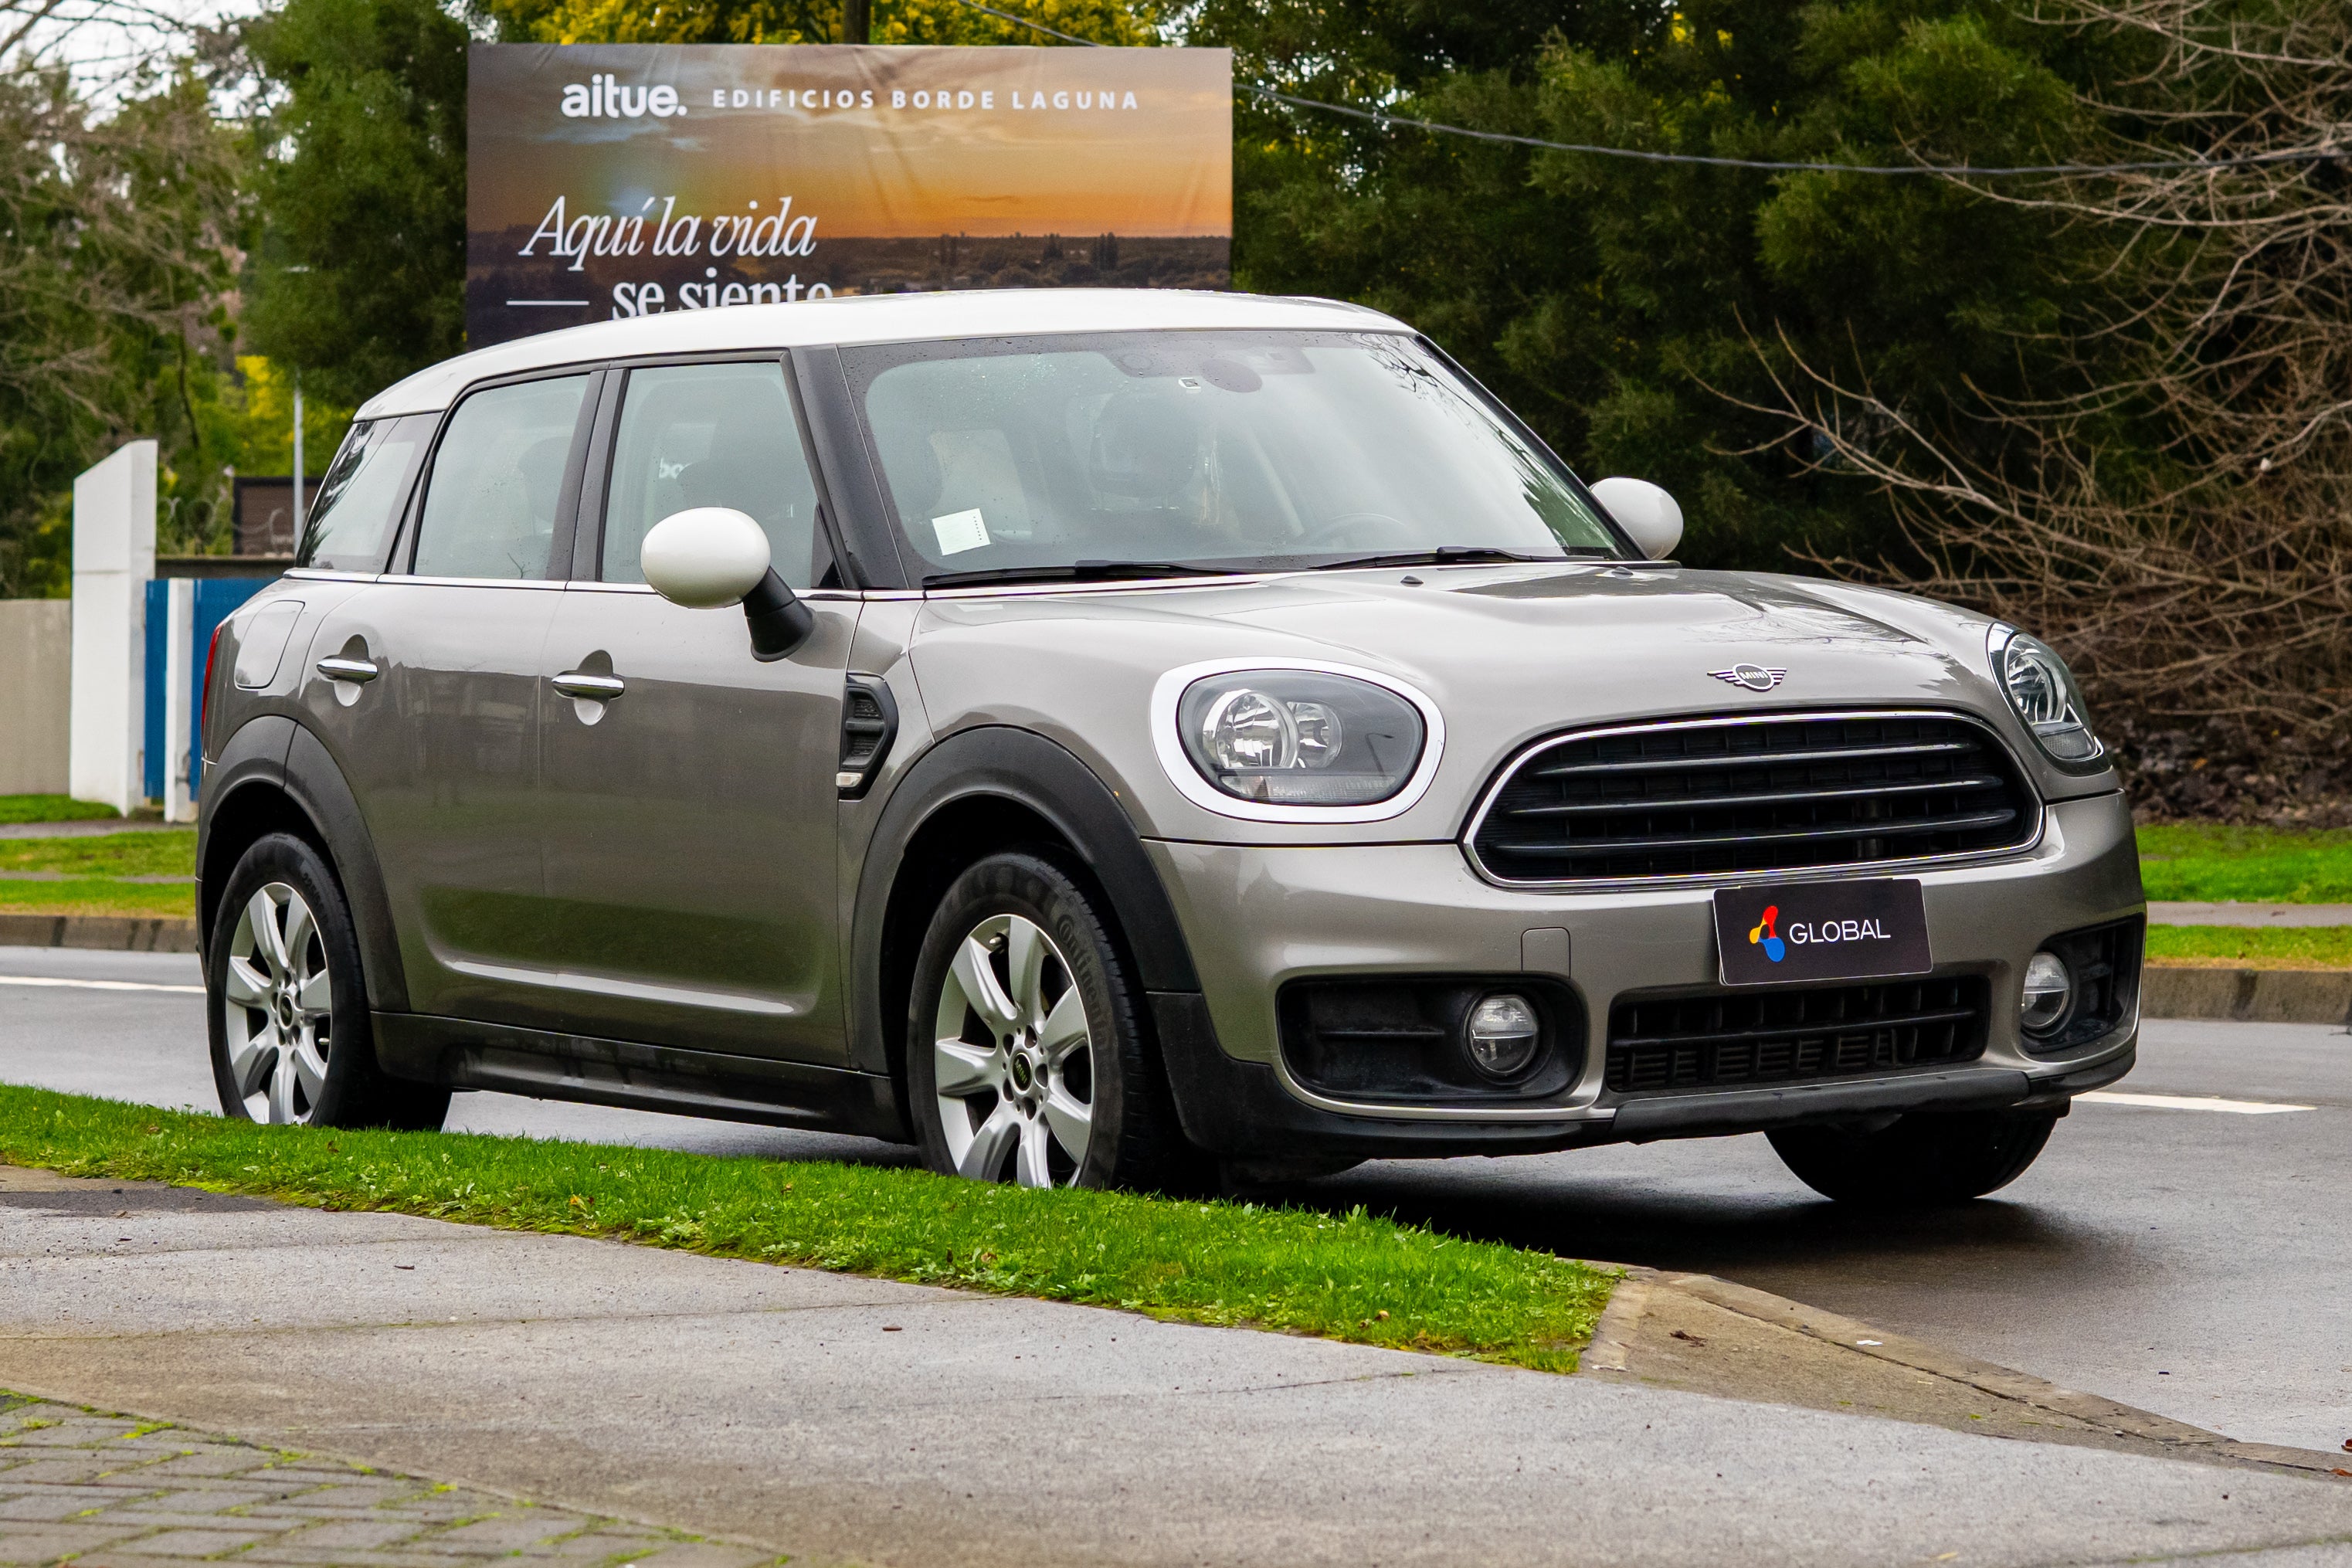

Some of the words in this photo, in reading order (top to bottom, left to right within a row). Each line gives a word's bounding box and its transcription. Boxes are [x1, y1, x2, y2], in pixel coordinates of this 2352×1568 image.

[561, 73, 687, 117] aitue.
[713, 89, 874, 109] EDIFICIOS
[891, 90, 994, 110] BORDE
[1012, 90, 1138, 110] LAGUNA
[518, 195, 654, 272] Aquí
[653, 195, 701, 257] la
[709, 195, 818, 257] vida
[612, 282, 665, 320] se
[1739, 670, 1769, 680] MINI
[1789, 918, 1891, 945] GLOBAL
[1014, 1058, 1028, 1084] MINI
